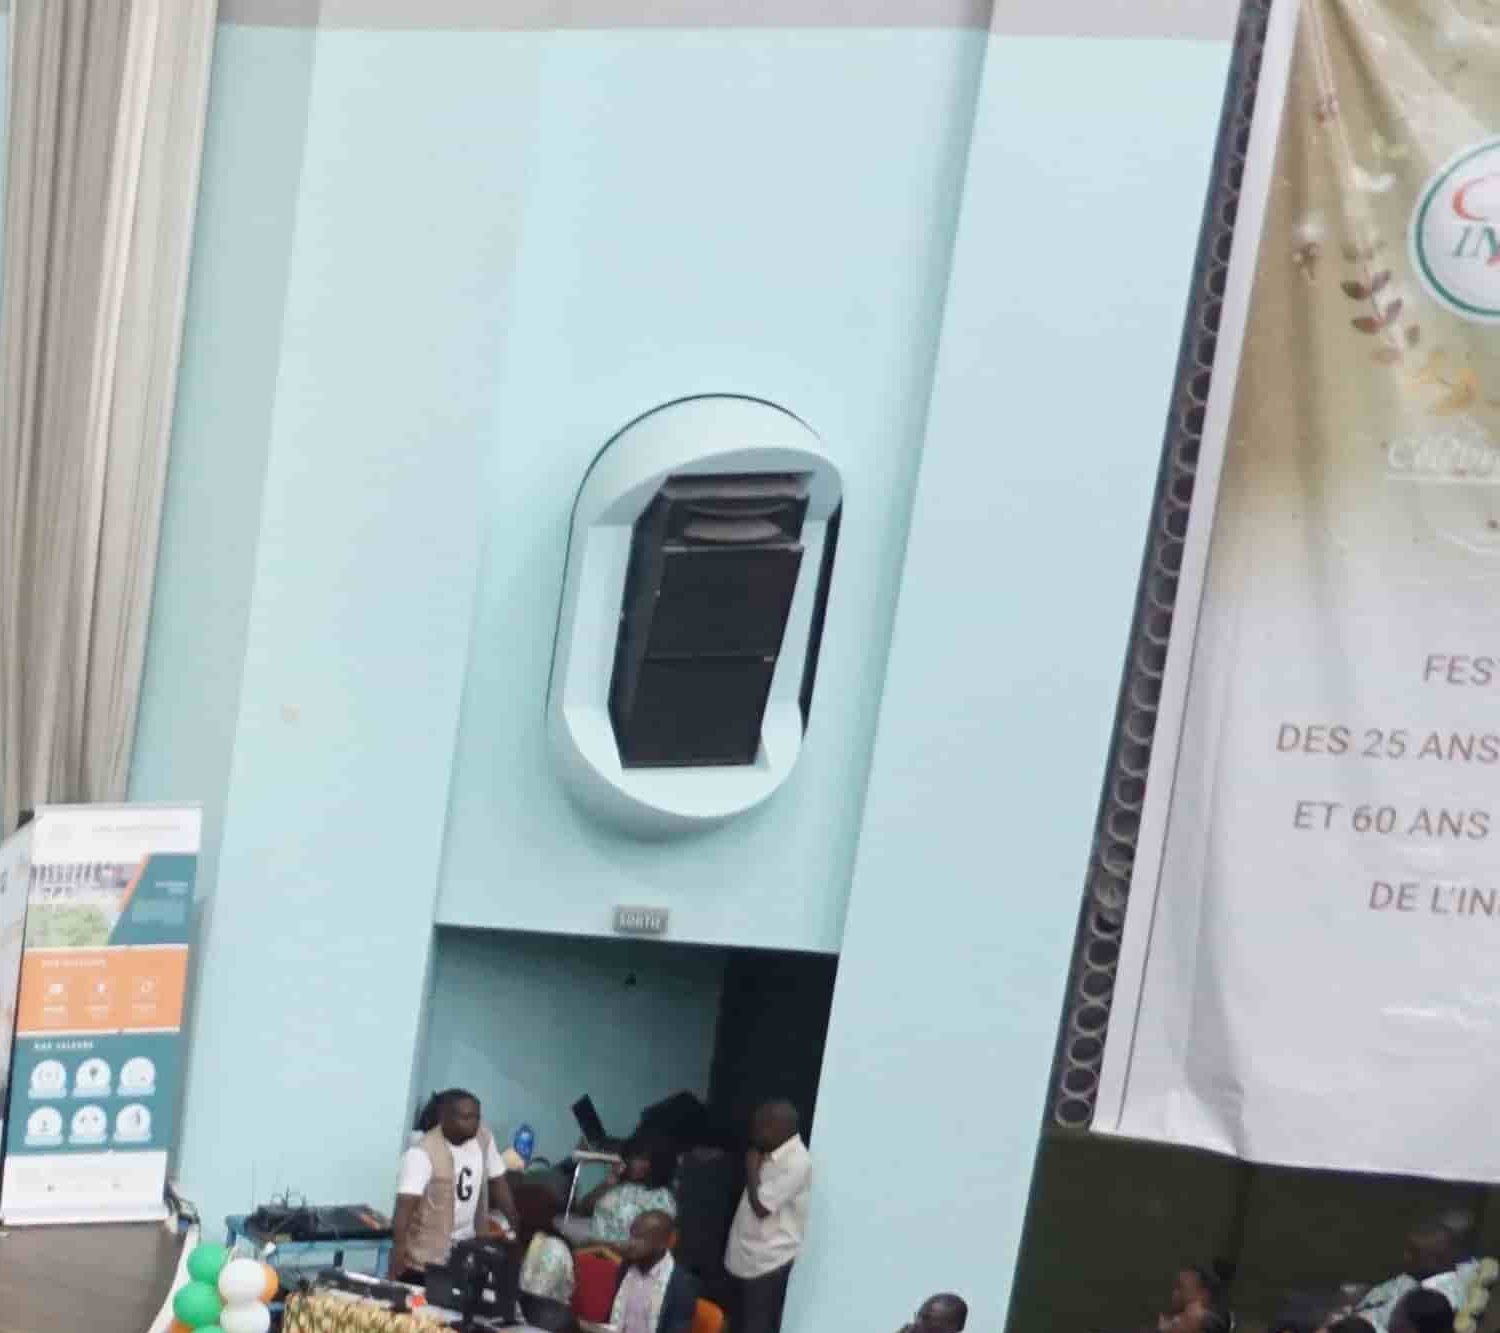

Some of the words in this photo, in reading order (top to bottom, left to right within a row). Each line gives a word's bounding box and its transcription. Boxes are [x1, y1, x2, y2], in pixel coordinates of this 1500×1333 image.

[1276, 722, 1350, 755] DES
[1362, 728, 1406, 759] 25
[1418, 731, 1500, 764] ANS
[1293, 800, 1343, 830] ET
[1351, 805, 1396, 834] 60
[1408, 807, 1491, 840] ANS
[1369, 881, 1421, 911] DE
[1431, 885, 1500, 917] L'IN
[457, 1168, 473, 1201] G
